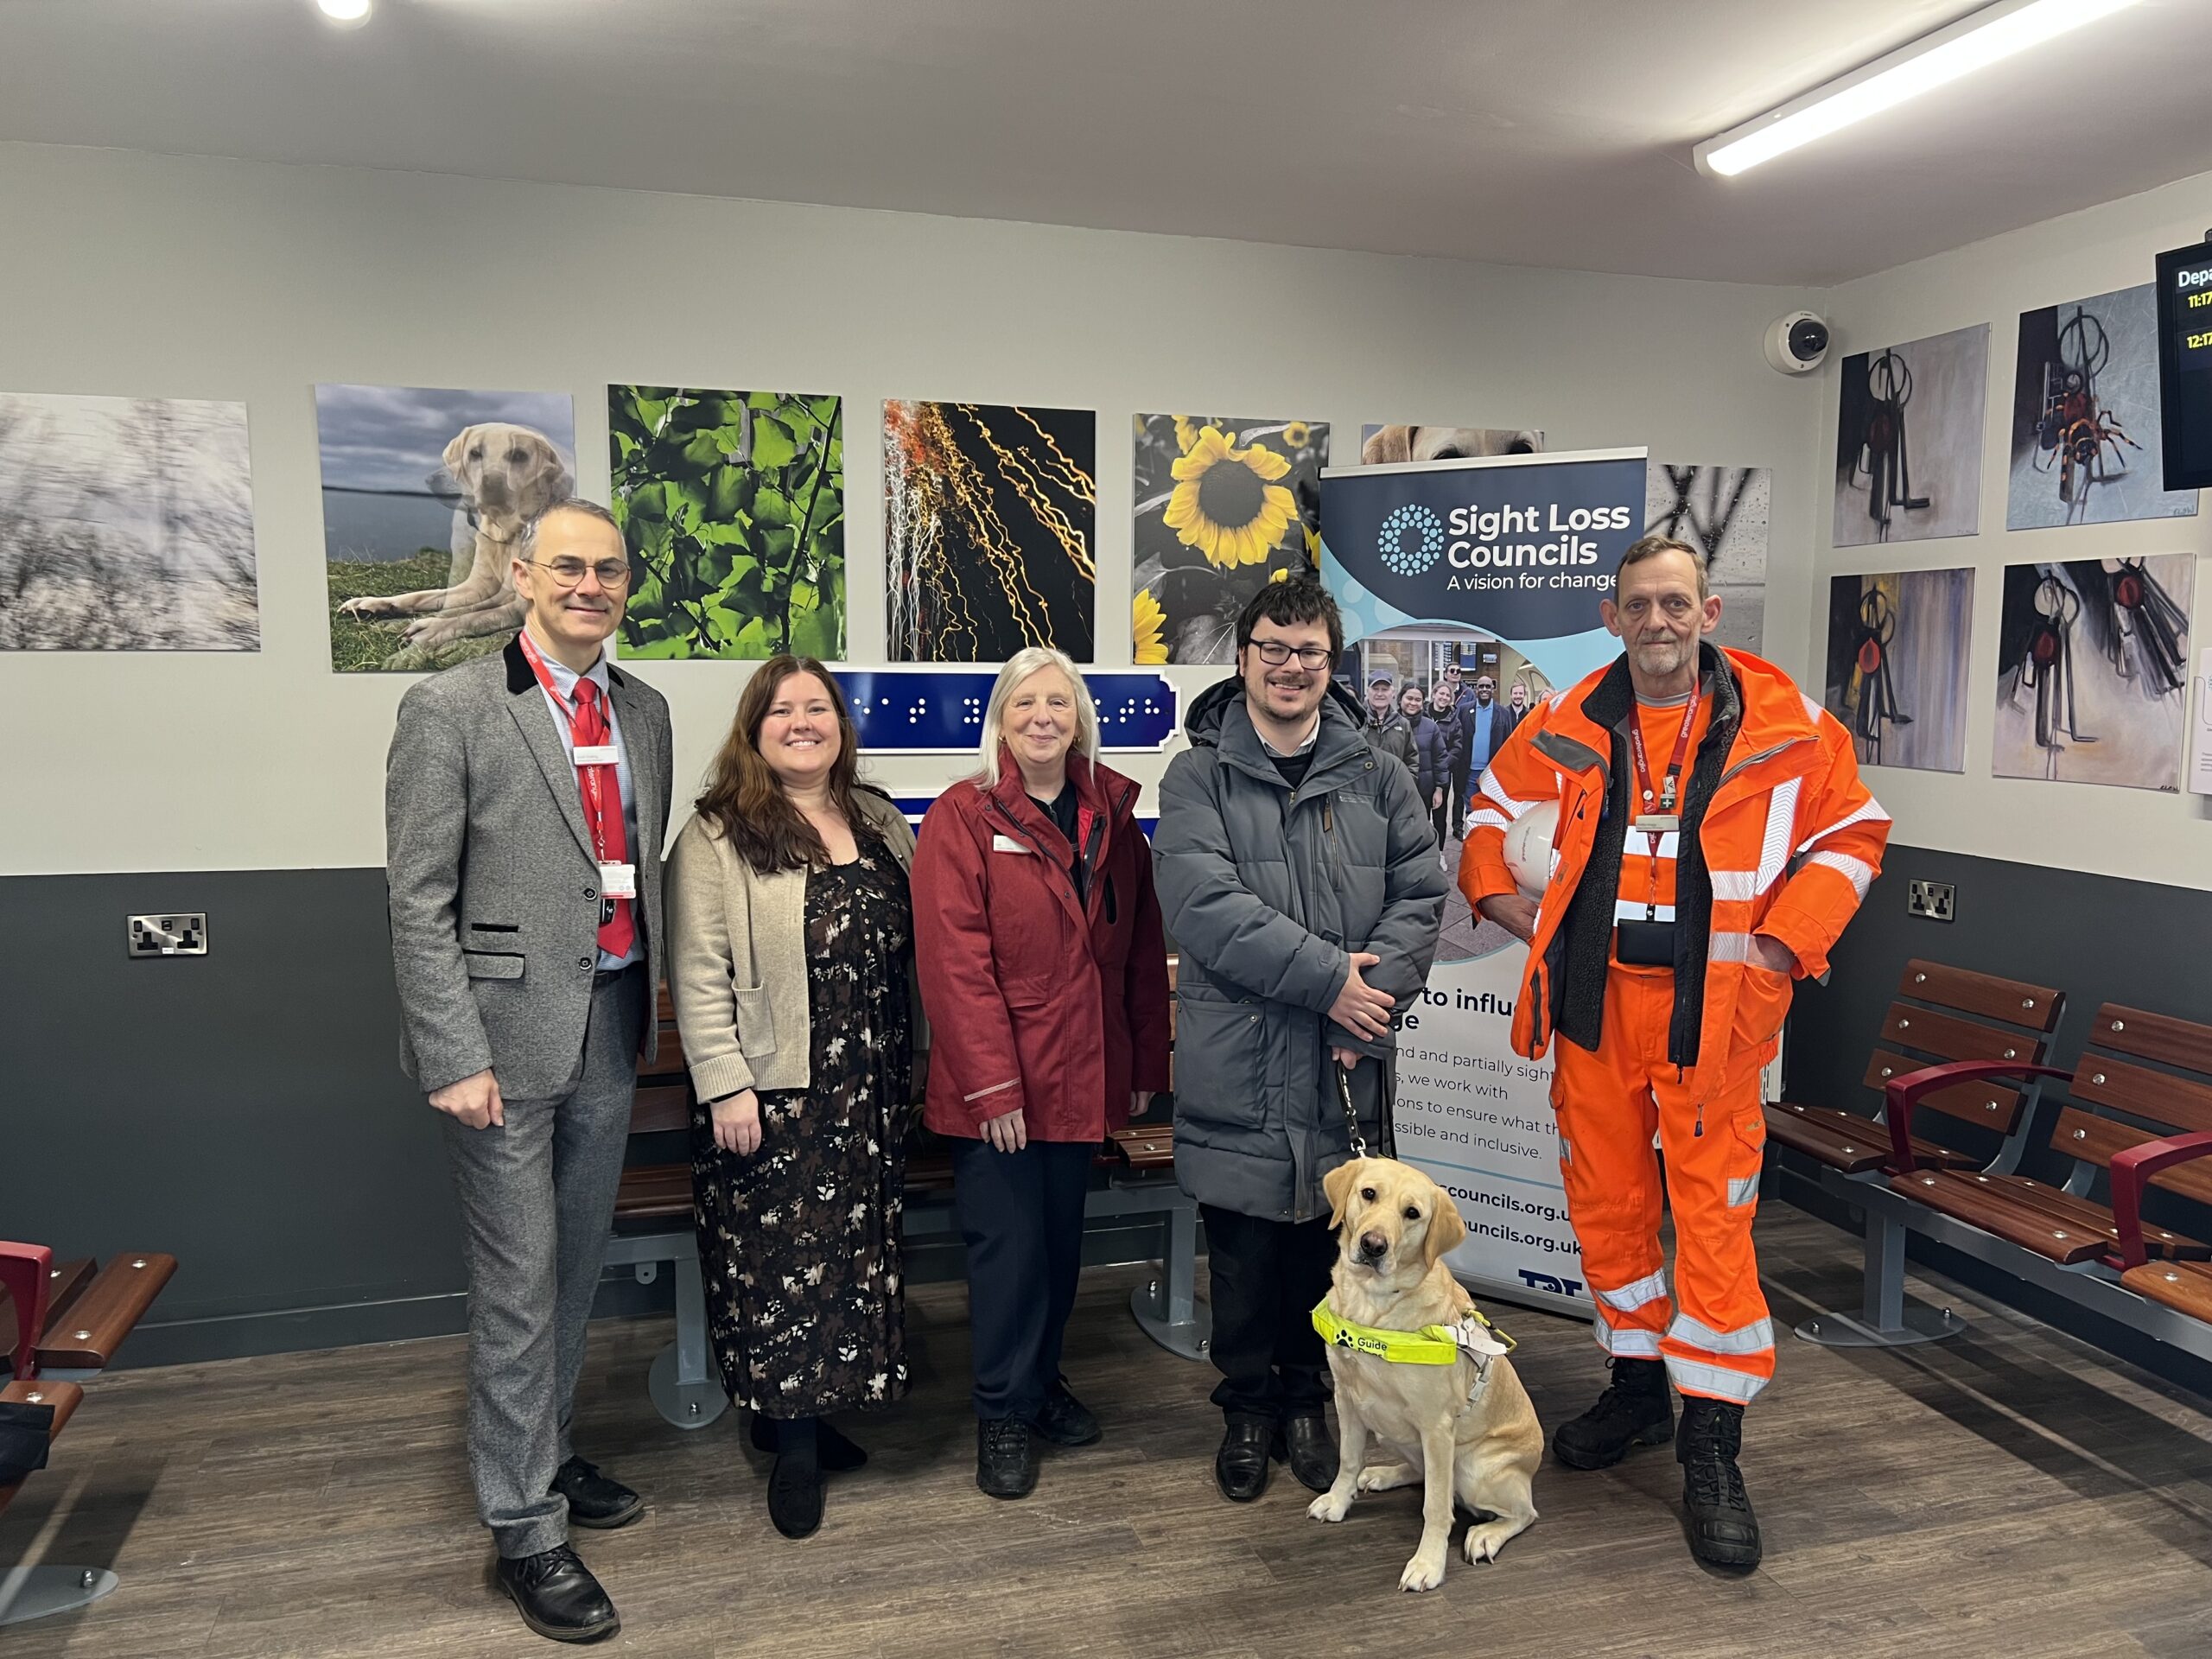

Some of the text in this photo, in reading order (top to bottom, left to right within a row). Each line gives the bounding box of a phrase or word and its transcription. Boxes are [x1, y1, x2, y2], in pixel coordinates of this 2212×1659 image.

[1448, 504, 1631, 542] Sight Loss
[1447, 534, 1598, 569] Councils
[1446, 575, 1460, 591] A
[1464, 573, 1513, 590] vision
[1519, 572, 1545, 588] for
[1422, 987, 1516, 1017] to influ
[1419, 1051, 1448, 1064] and
[1453, 1054, 1513, 1077] partially
[1408, 1073, 1430, 1086] we
[1434, 1077, 1471, 1094] work
[1475, 1083, 1509, 1100] with
[1393, 1097, 1423, 1111] ons
[1427, 1101, 1443, 1114] to
[1446, 1105, 1498, 1124] ensure
[1502, 1116, 1541, 1133] what
[1395, 1122, 1542, 1160] ssible and inclusive.
[1434, 1183, 1569, 1222] councils.org.u
[1464, 1220, 1582, 1256] uncils.org.uk
[1357, 1337, 1388, 1351] Guide
